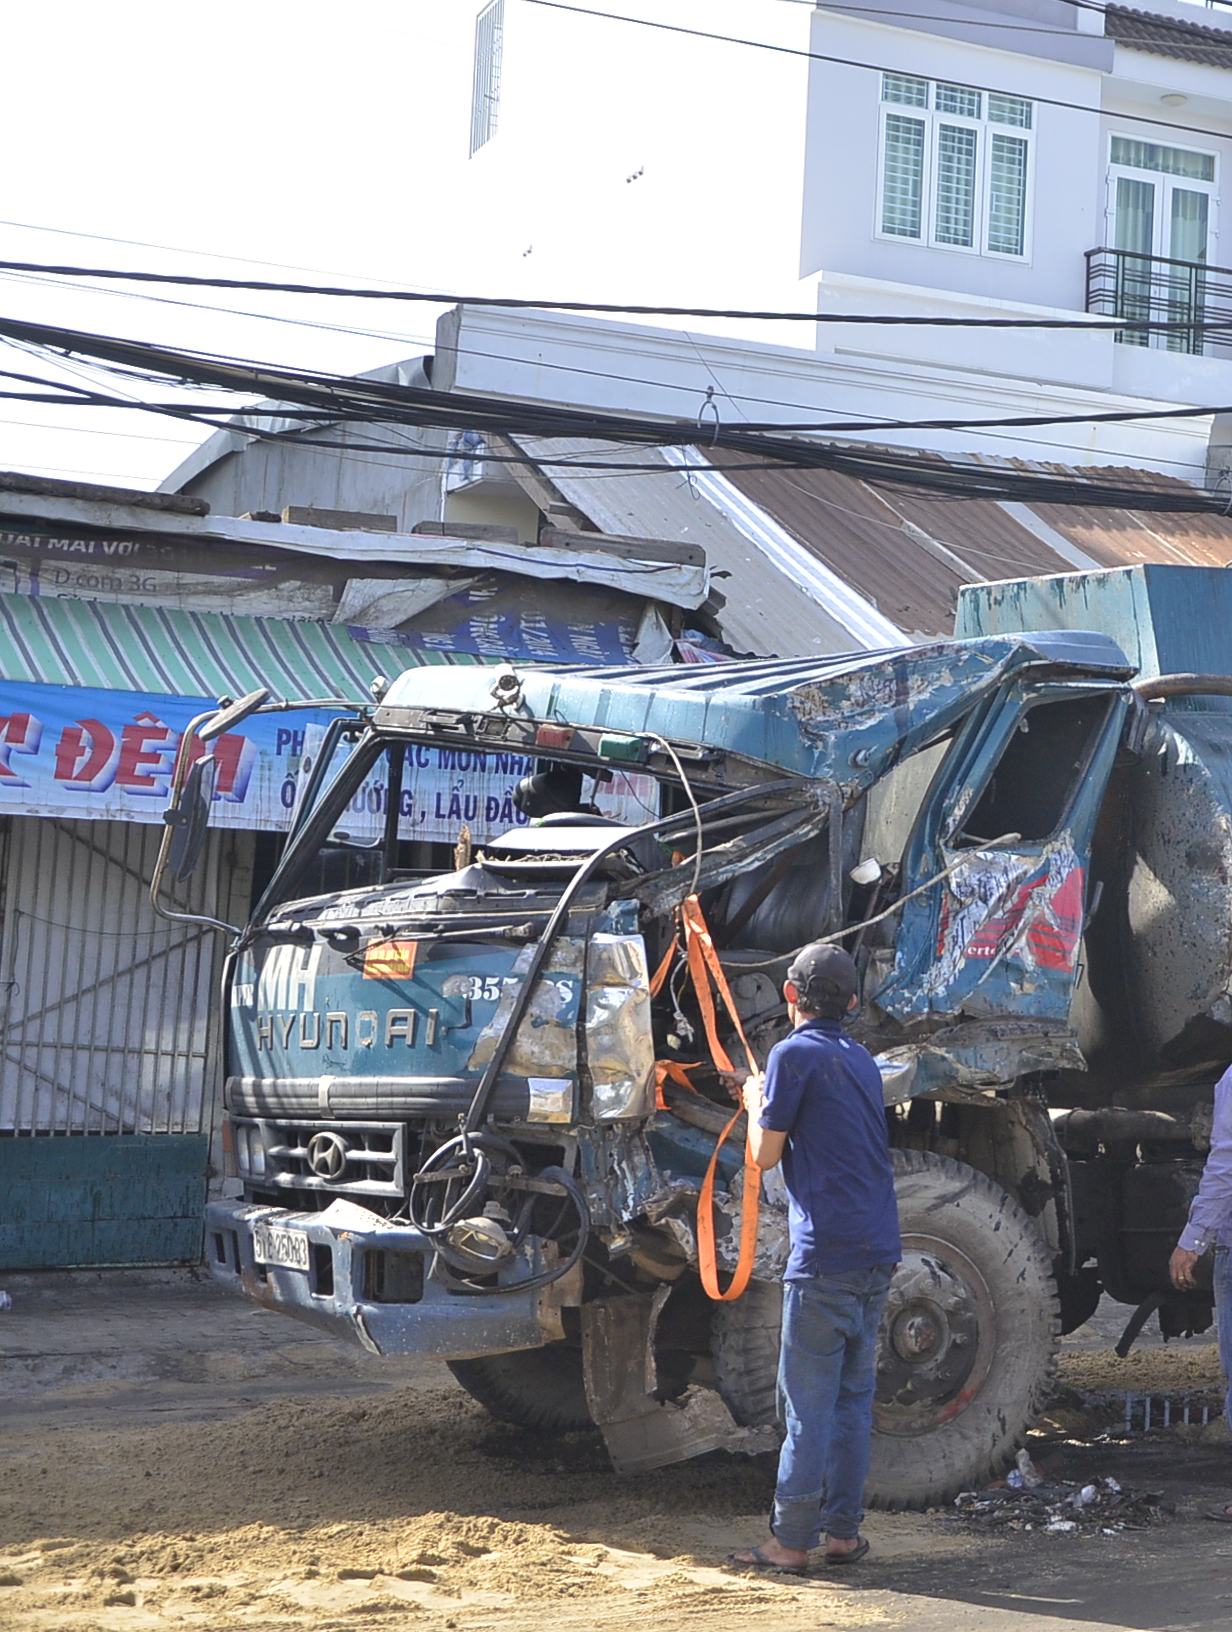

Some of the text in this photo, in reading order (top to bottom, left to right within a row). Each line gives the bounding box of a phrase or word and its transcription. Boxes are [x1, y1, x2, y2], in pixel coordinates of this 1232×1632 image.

[130, 575, 157, 592] 3G
[54, 710, 252, 800] ĐÊM
[435, 778, 478, 822] LẨU
[257, 1008, 439, 1050] HYUNDAI
